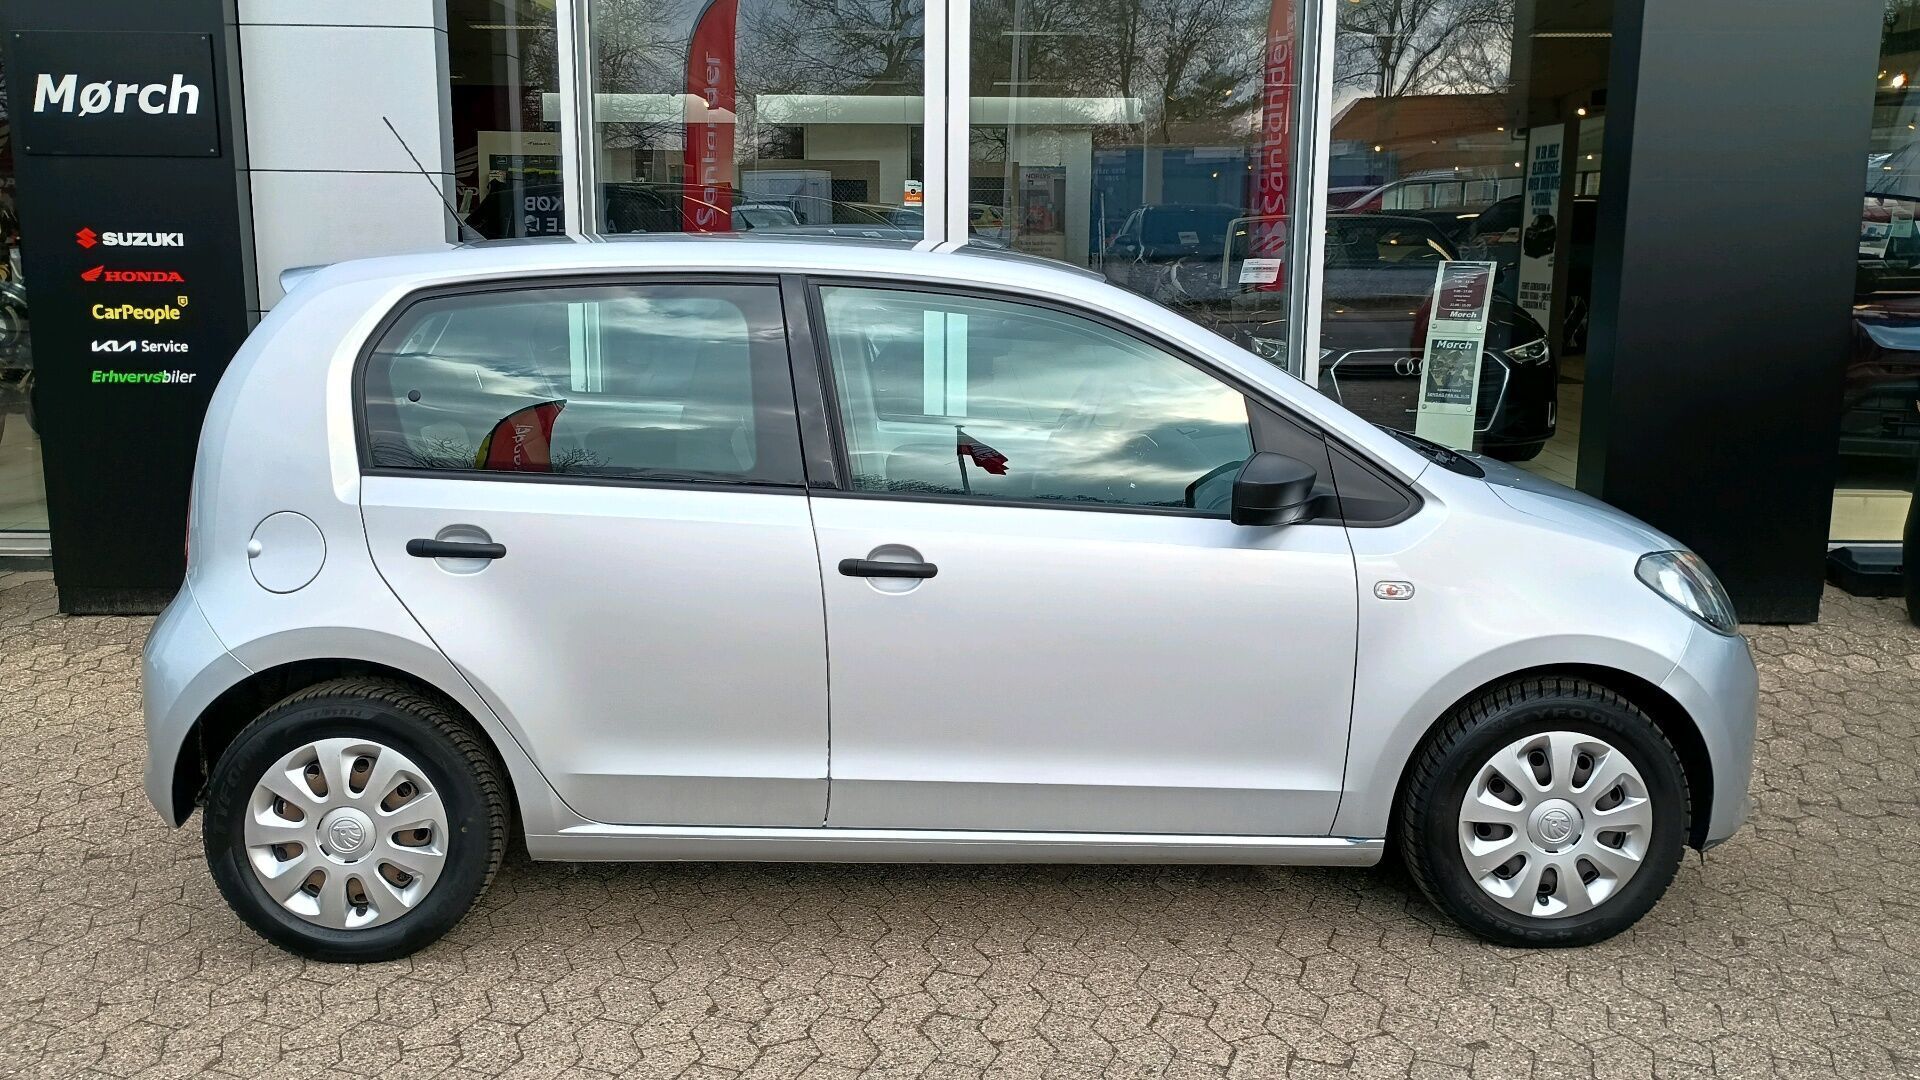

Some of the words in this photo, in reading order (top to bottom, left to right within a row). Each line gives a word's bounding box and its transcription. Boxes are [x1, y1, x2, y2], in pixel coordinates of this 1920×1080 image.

[33, 73, 200, 117] Mørch
[1265, 29, 1289, 214] Santander
[696, 51, 721, 226] Santander
[102, 231, 184, 247] SUZUKI
[104, 271, 185, 282] HONDA
[92, 304, 180, 324] CarPeople
[91, 340, 137, 352] KIA
[141, 340, 189, 352] Service
[1436, 340, 1472, 350] Mørch
[92, 370, 197, 384] Erhvervsbiler
[1511, 707, 1626, 732] TYFOON
